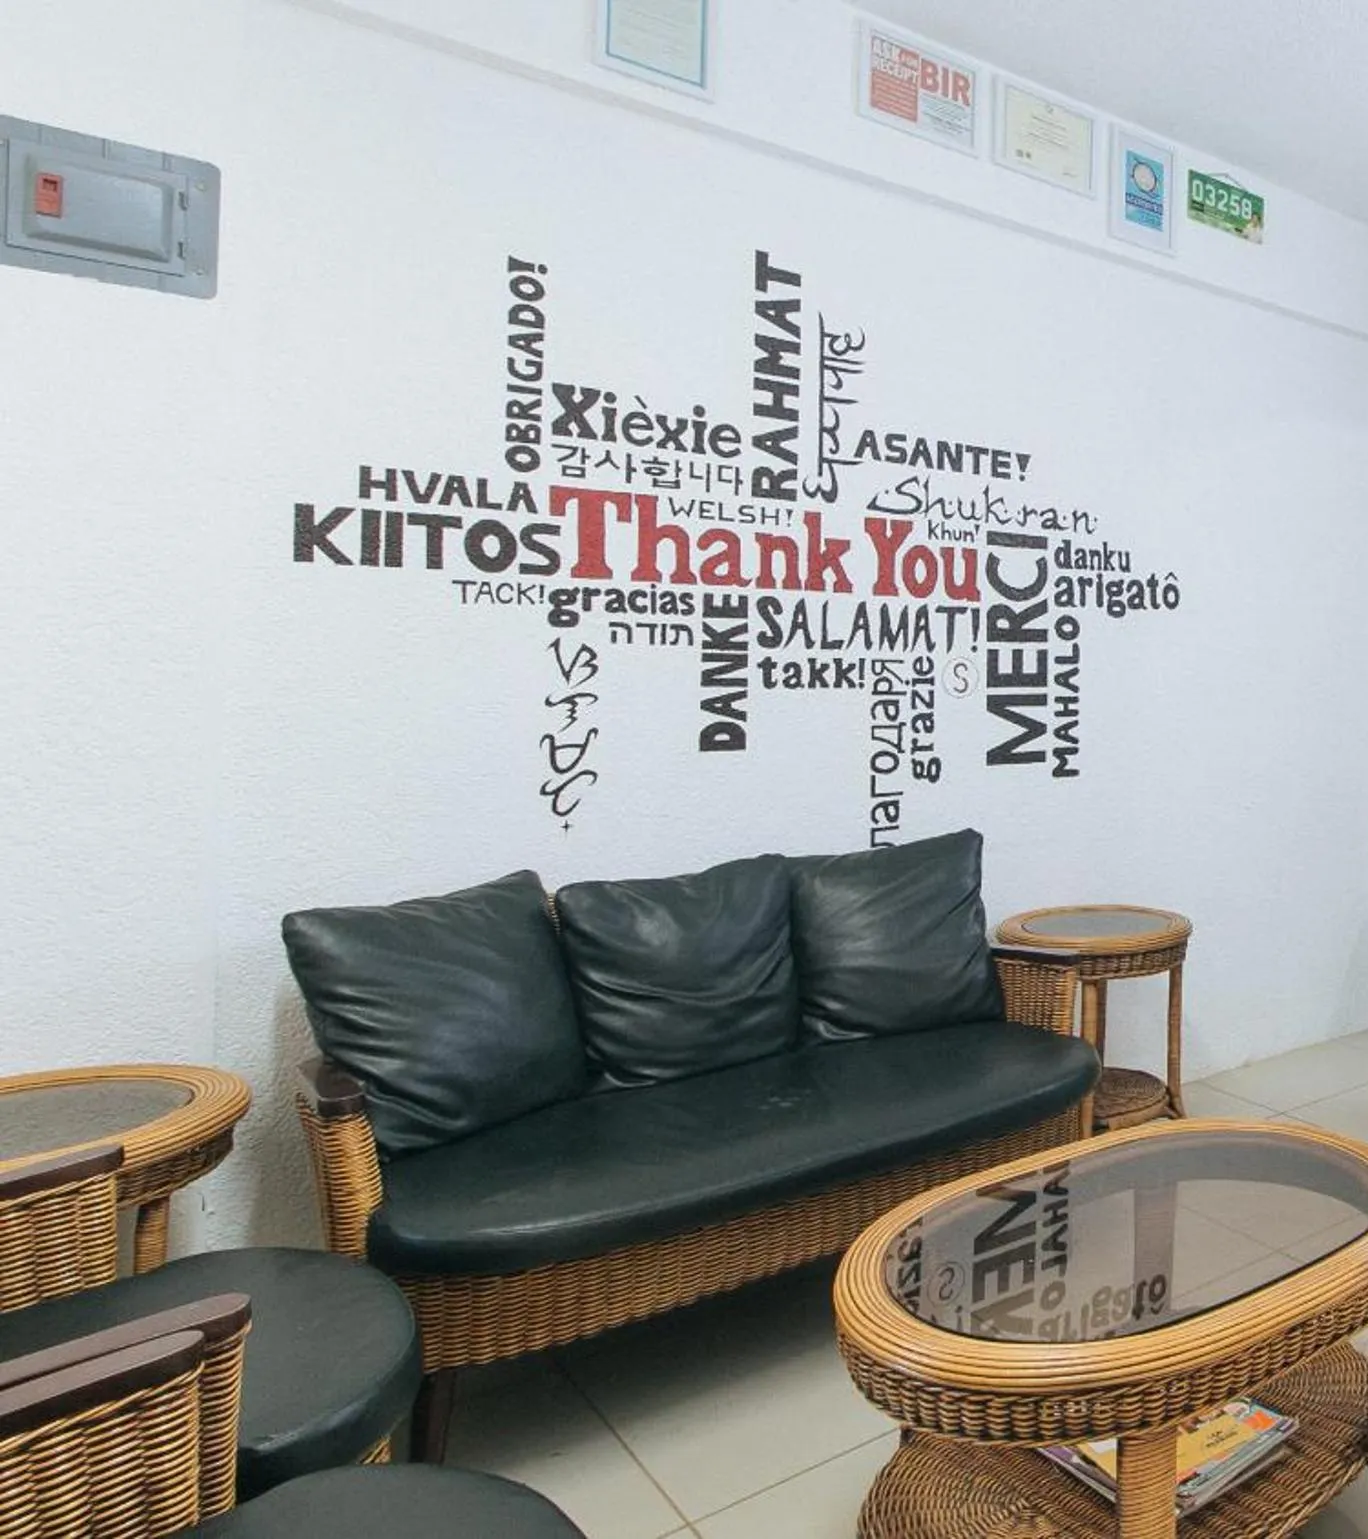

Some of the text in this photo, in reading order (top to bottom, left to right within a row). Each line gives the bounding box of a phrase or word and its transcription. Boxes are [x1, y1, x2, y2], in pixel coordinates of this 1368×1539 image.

[920, 58, 971, 107] BIR
[1191, 179, 1253, 220] 03258
[504, 255, 549, 473] OBRIGADO!
[751, 249, 802, 502] RAHMAT
[551, 382, 742, 459] Xièxie
[551, 443, 743, 496] 감사합니다
[854, 429, 1032, 480] ASANTE!
[358, 464, 539, 515] HVALA
[667, 496, 794, 528] WELSH!
[866, 475, 1098, 535] Shukran
[292, 502, 562, 577] KIITOS
[549, 485, 982, 603] Thank You
[1053, 539, 1132, 574] danku
[452, 579, 546, 606] TACK!
[547, 583, 697, 628] gracias
[1053, 572, 1181, 619] arigatô
[608, 621, 695, 647] תודה
[756, 596, 982, 655] SALAMAT!
[985, 530, 1049, 766] MERCI
[698, 592, 749, 753] DANKE
[757, 656, 867, 691] takk!
[1051, 613, 1081, 779] MAHALO
[904, 655, 942, 784] grazie
[870, 657, 905, 848] лагодаря
